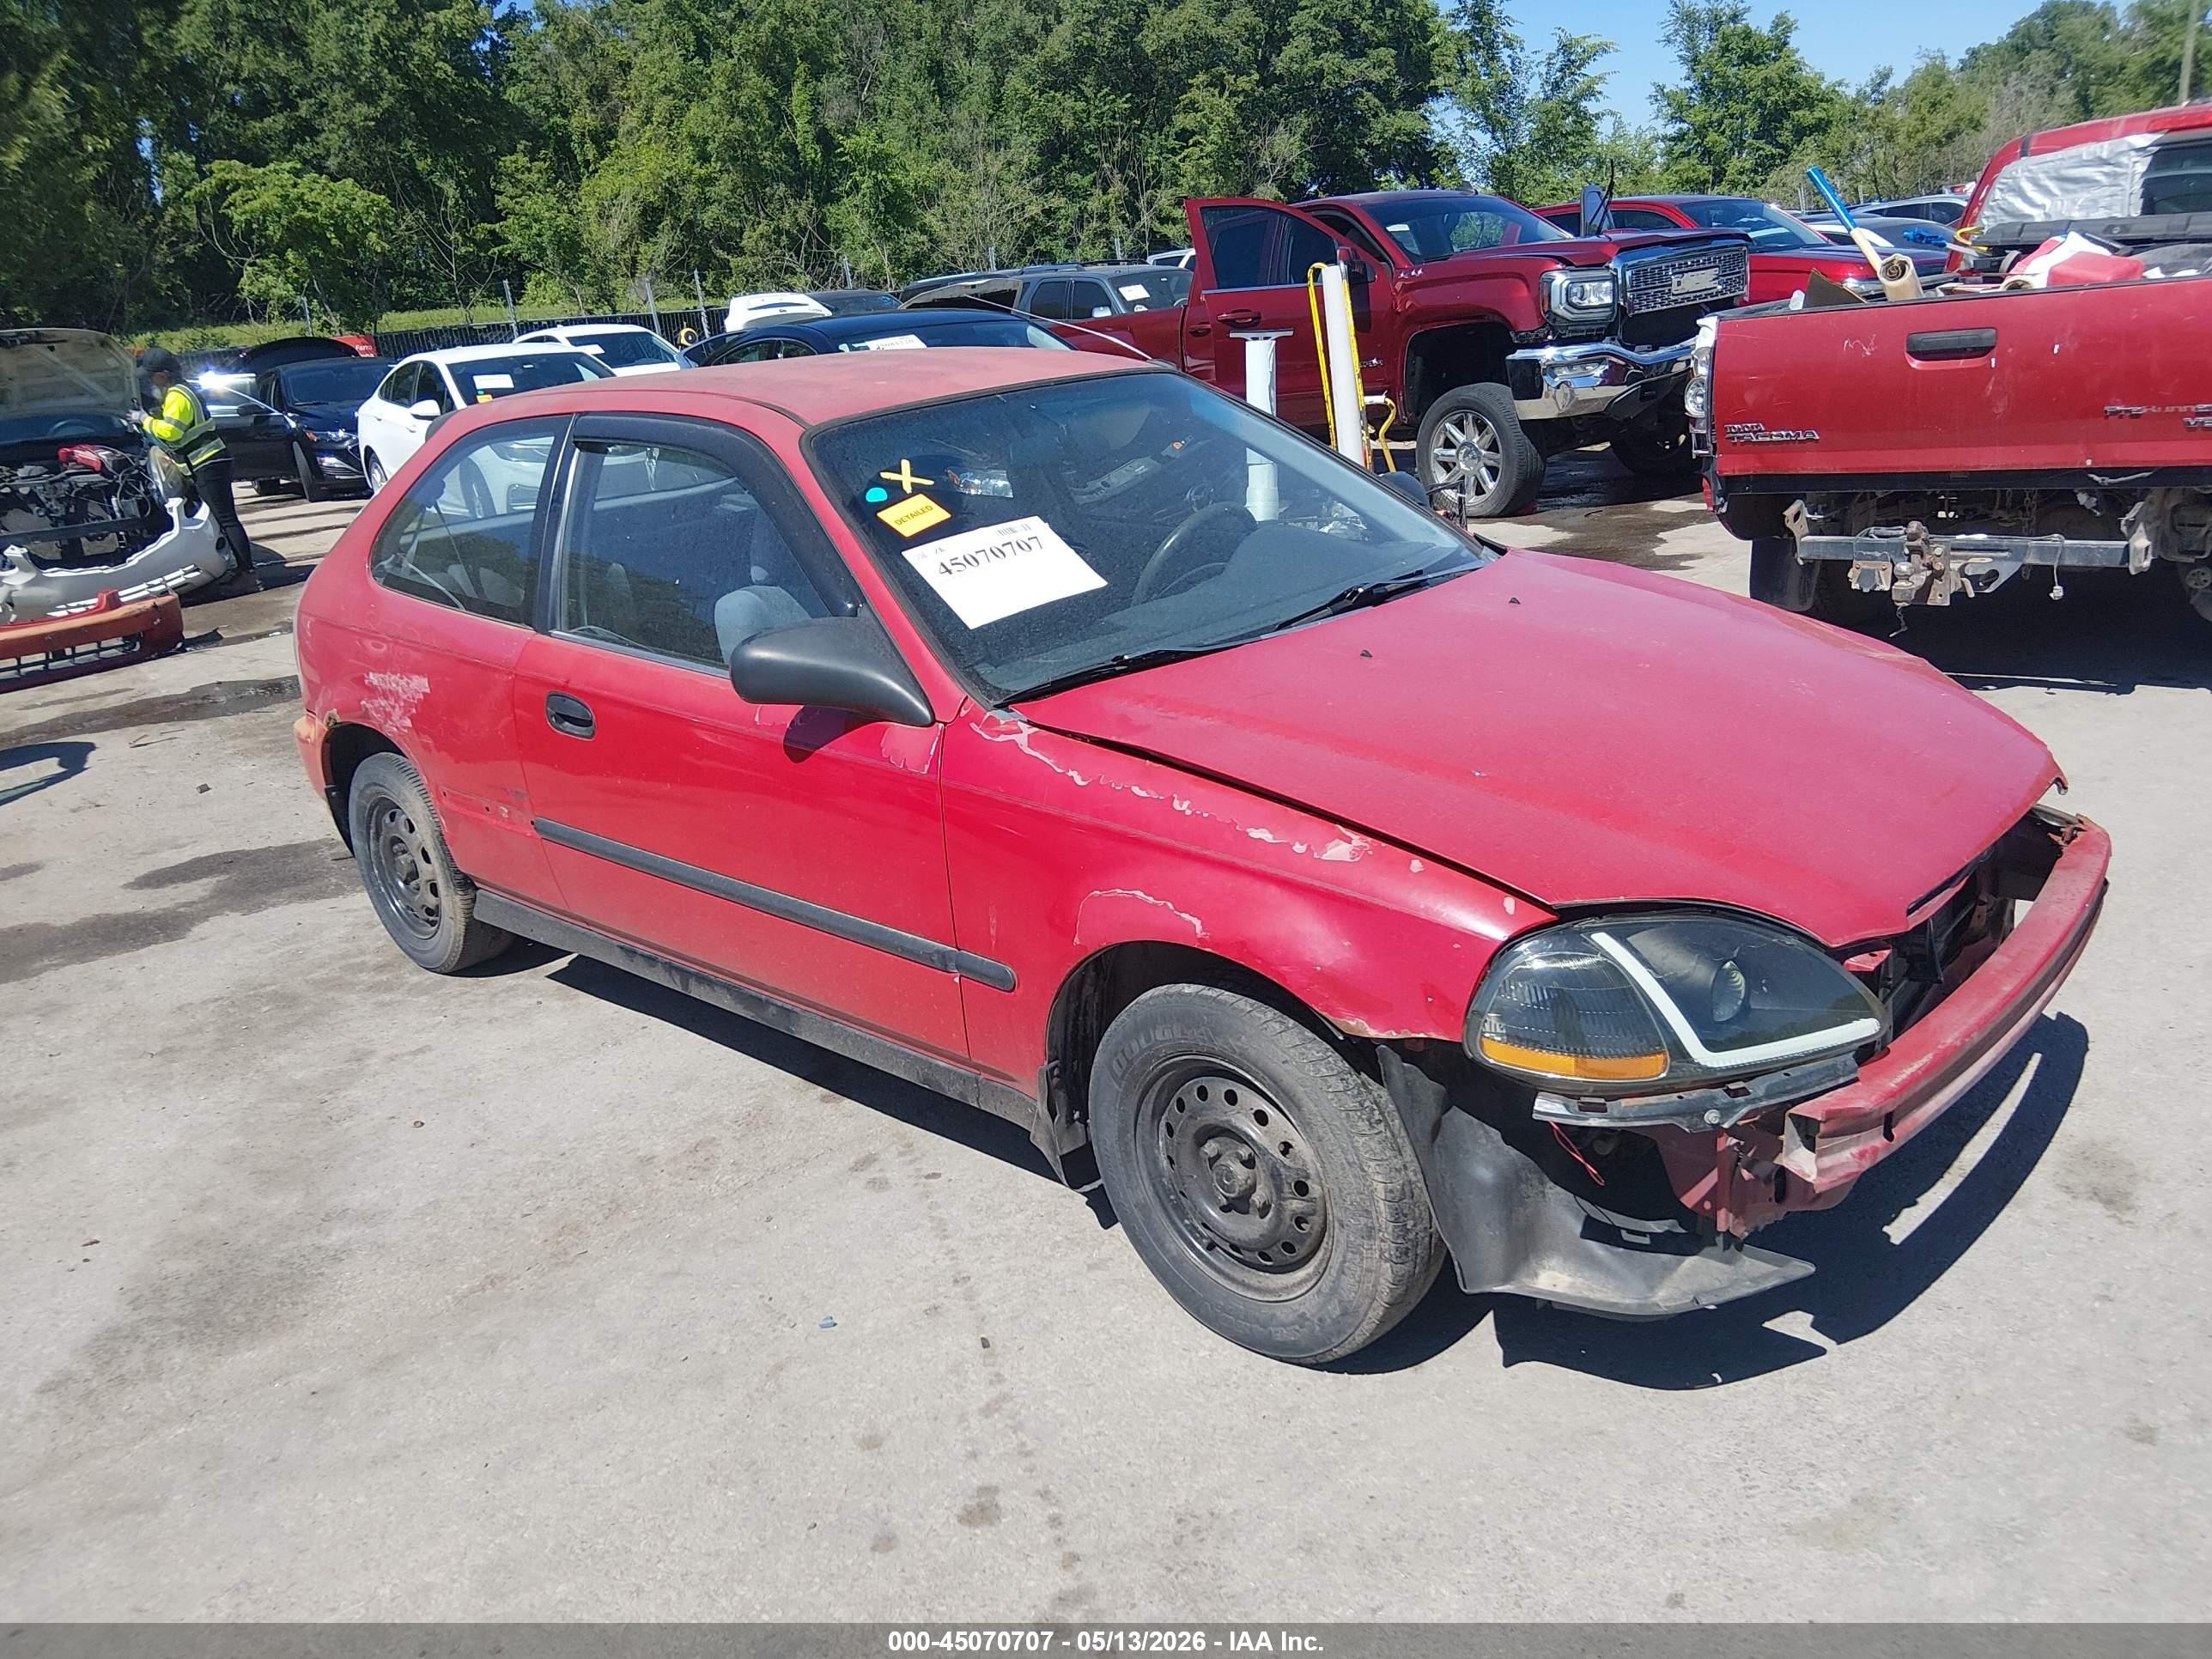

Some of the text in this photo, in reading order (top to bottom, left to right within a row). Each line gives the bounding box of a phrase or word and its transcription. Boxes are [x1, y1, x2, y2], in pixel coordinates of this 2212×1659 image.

[2103, 404, 2212, 416] PreRunne
[1724, 422, 1765, 432] TOYOTA
[1725, 430, 1820, 443] TACOMA
[894, 505, 933, 526] DETAILED
[939, 536, 1043, 575] 45070707
[1110, 1023, 1238, 1076] DOUGLA
